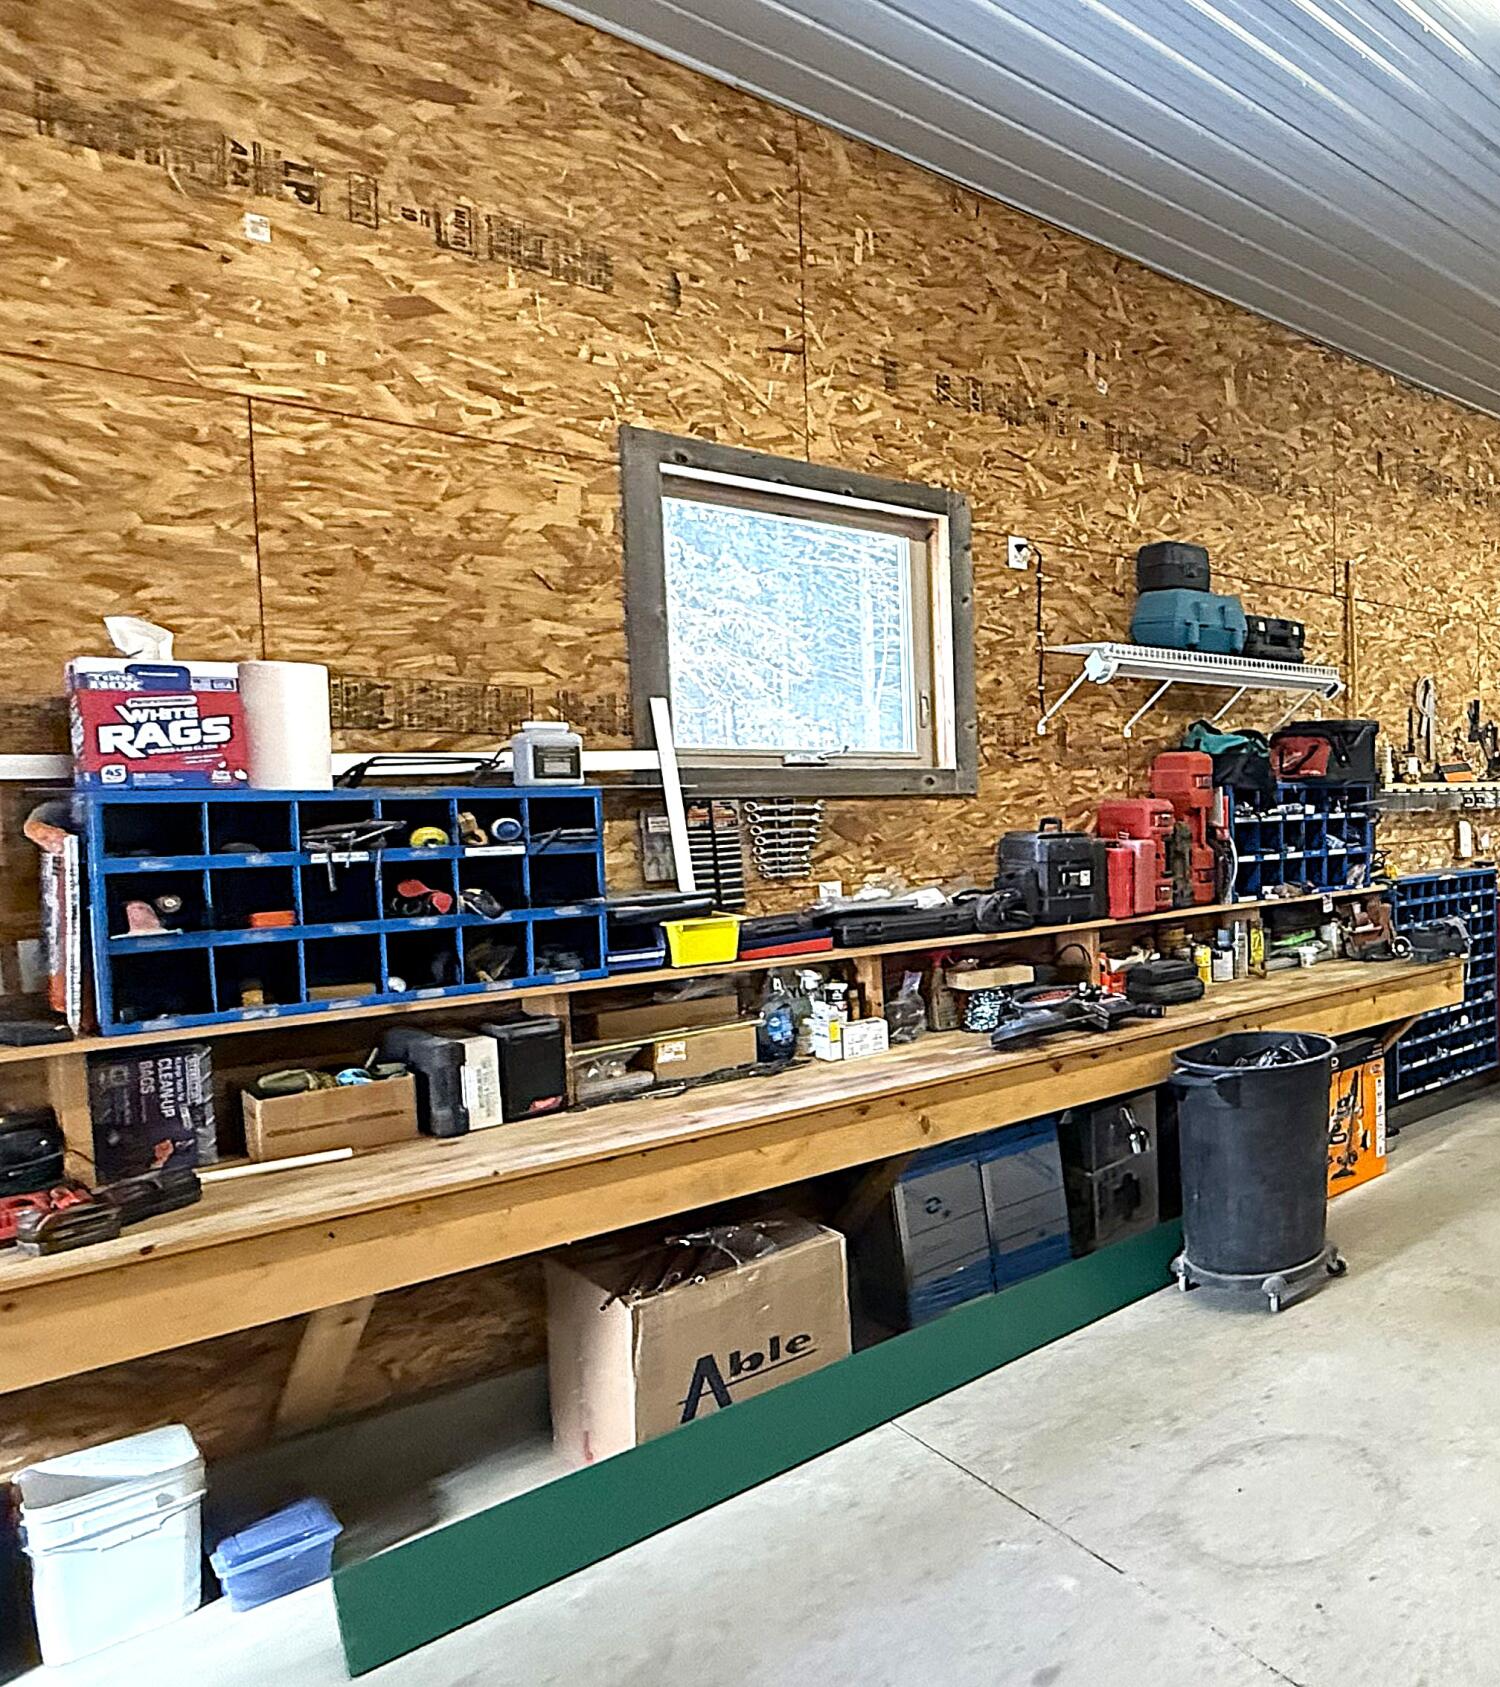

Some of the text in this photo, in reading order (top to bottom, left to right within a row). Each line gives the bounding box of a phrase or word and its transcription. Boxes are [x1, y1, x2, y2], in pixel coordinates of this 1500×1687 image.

[283, 160, 318, 206] LP
[114, 705, 199, 724] WHITE
[98, 716, 232, 759] RAGS
[138, 1060, 156, 1095] BAGS
[157, 1057, 176, 1118] CLEAN-UP
[679, 1333, 812, 1424] Able
